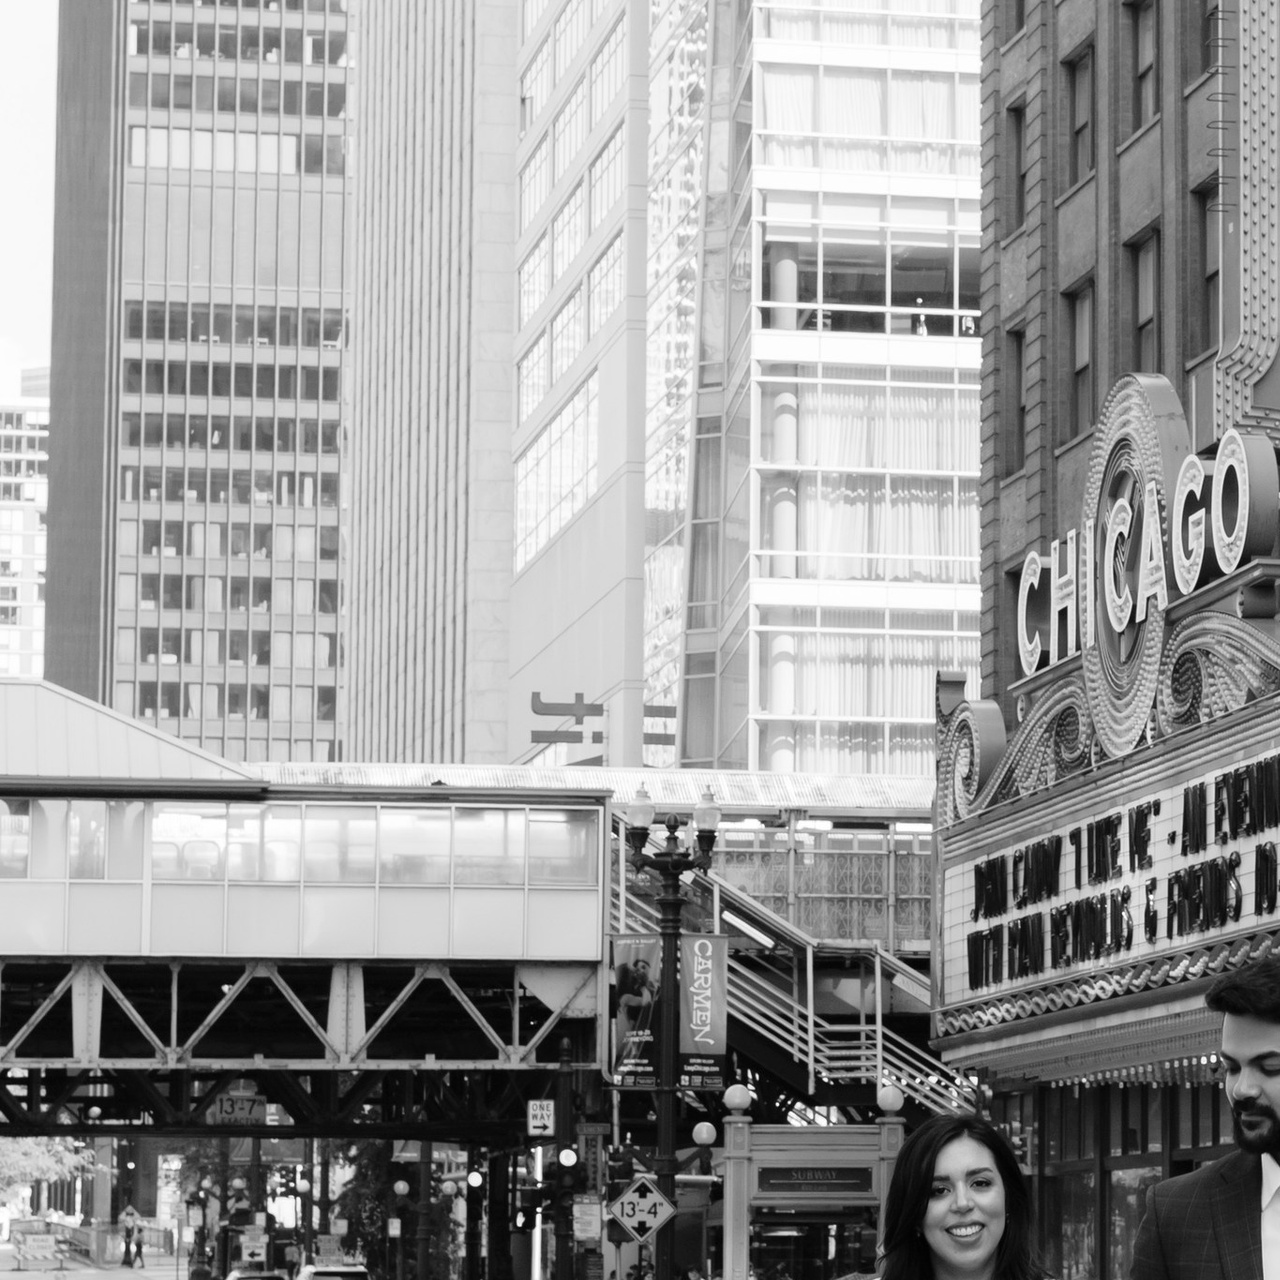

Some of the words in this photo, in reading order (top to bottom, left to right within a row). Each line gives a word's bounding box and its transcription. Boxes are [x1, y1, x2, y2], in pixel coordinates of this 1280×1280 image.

[1017, 428, 1249, 676] CHICAGO
[690, 939, 716, 1046] CARMEN
[531, 1103, 552, 1112] ONE
[531, 1113, 552, 1121] WAY
[791, 1169, 838, 1180] SUBWAY
